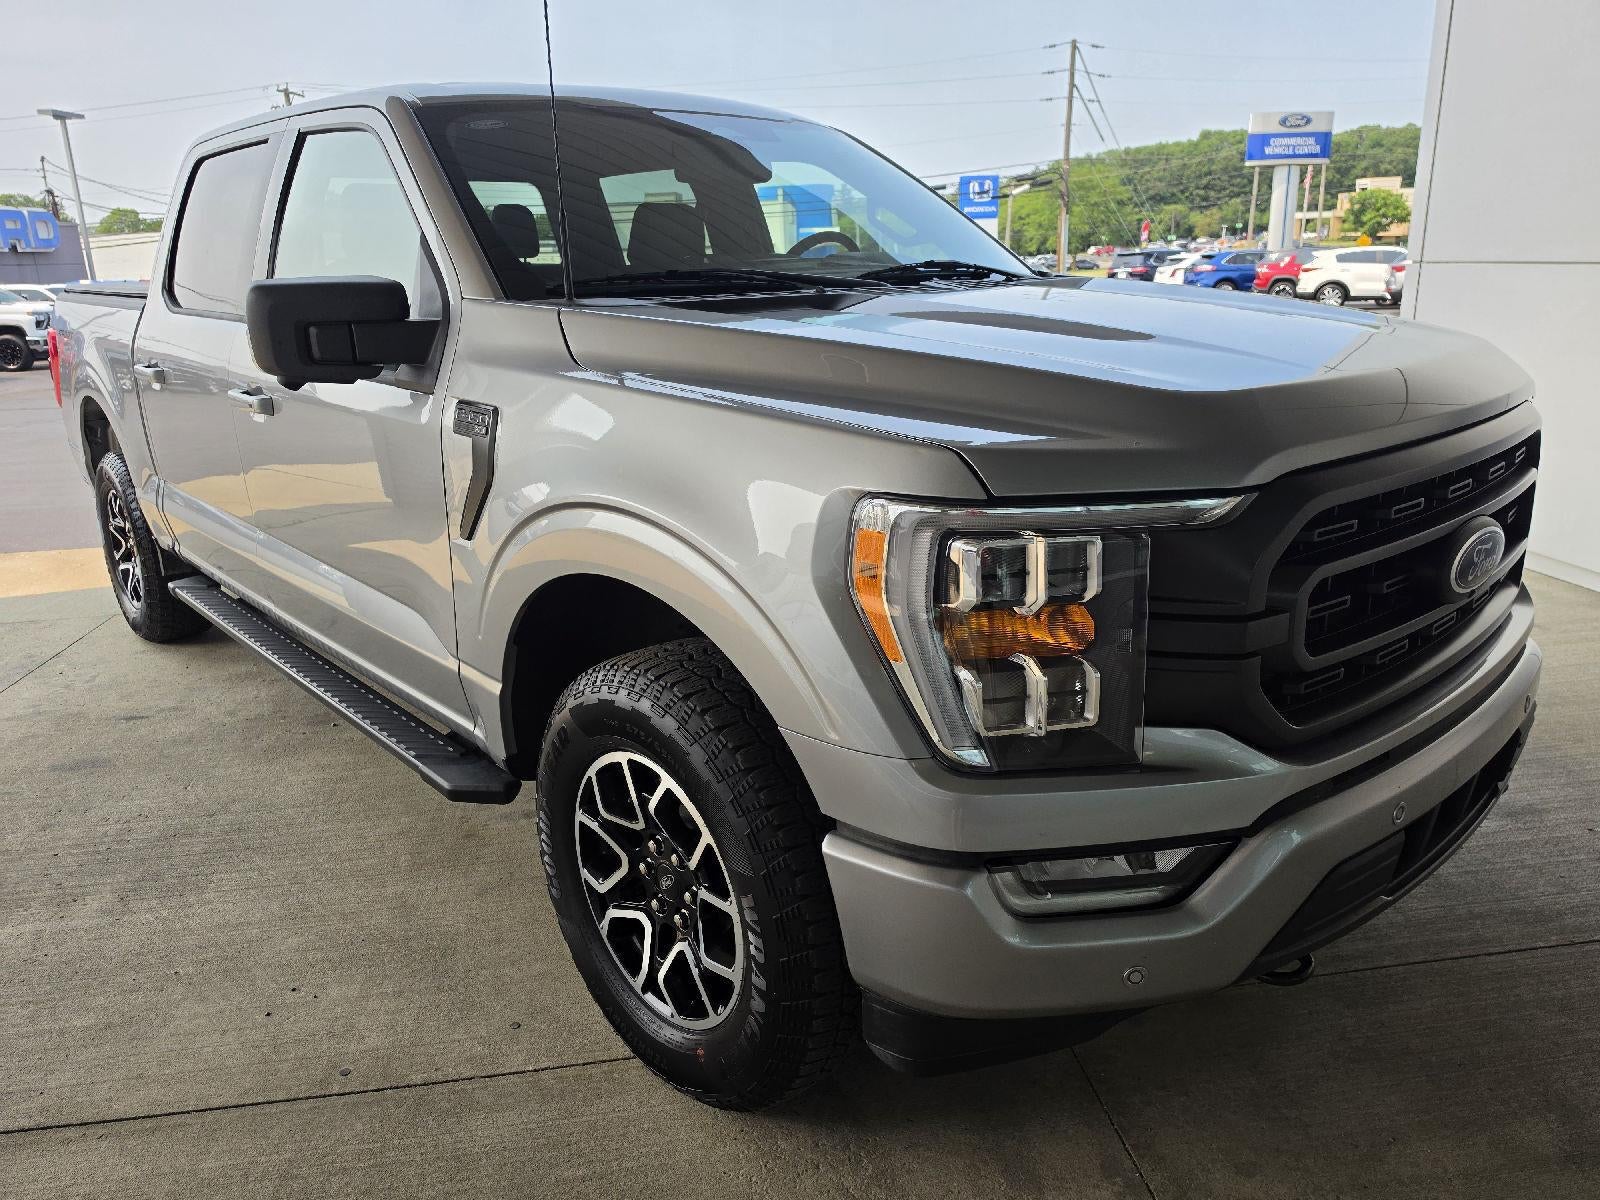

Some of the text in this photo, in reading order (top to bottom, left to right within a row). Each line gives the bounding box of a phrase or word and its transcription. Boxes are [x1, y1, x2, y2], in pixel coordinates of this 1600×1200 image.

[1270, 136, 1317, 146] COMMERCIAL
[1265, 144, 1321, 155] VEHICLE CENTER
[1467, 541, 1499, 581] Ford
